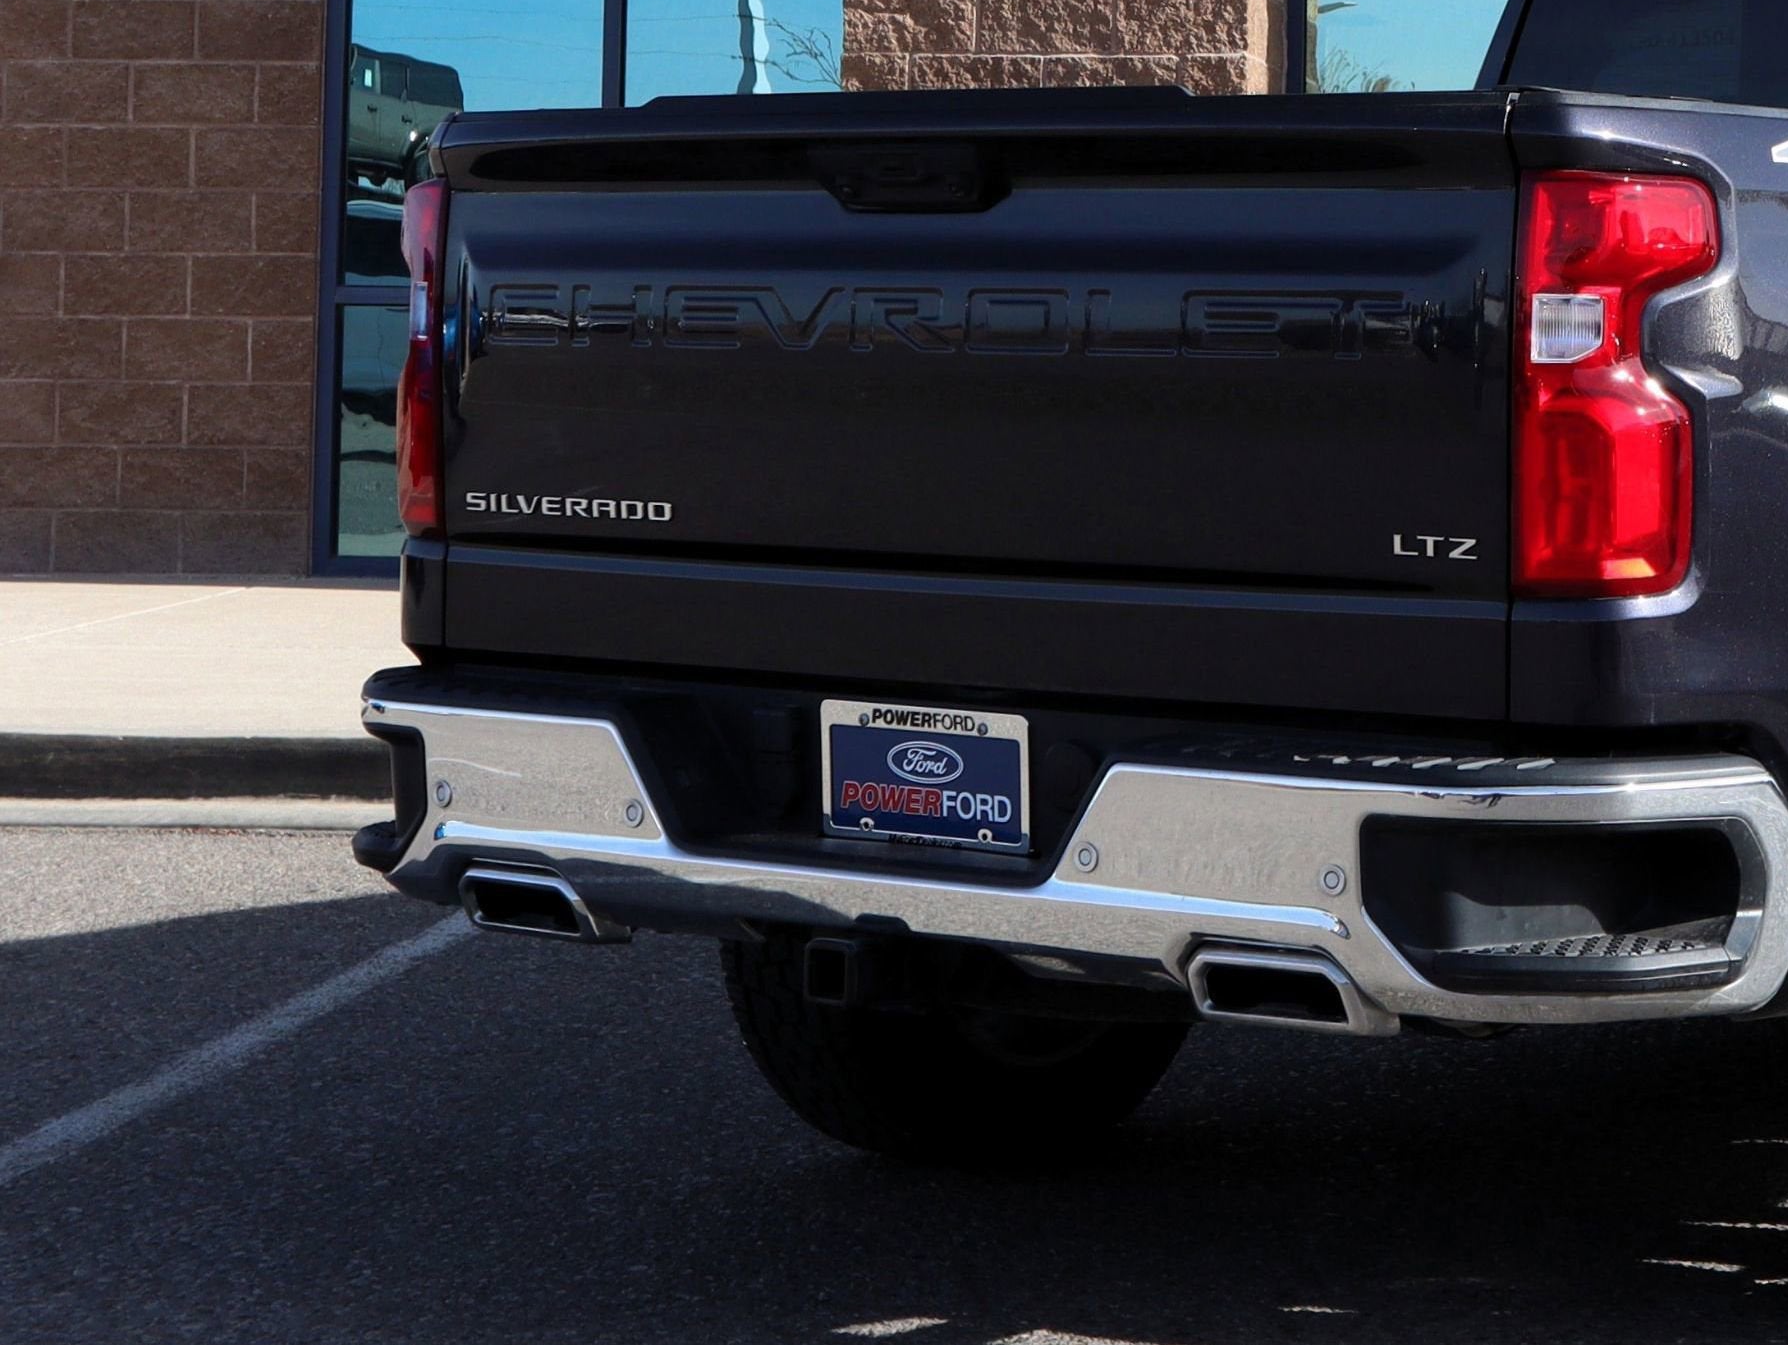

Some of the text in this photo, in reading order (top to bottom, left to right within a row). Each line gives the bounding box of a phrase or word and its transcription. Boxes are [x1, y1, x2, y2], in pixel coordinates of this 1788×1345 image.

[488, 284, 1412, 360] CHEVROLET
[465, 491, 673, 522] SILVERADO
[1392, 533, 1478, 560] LTZ
[902, 748, 949, 776] Ford
